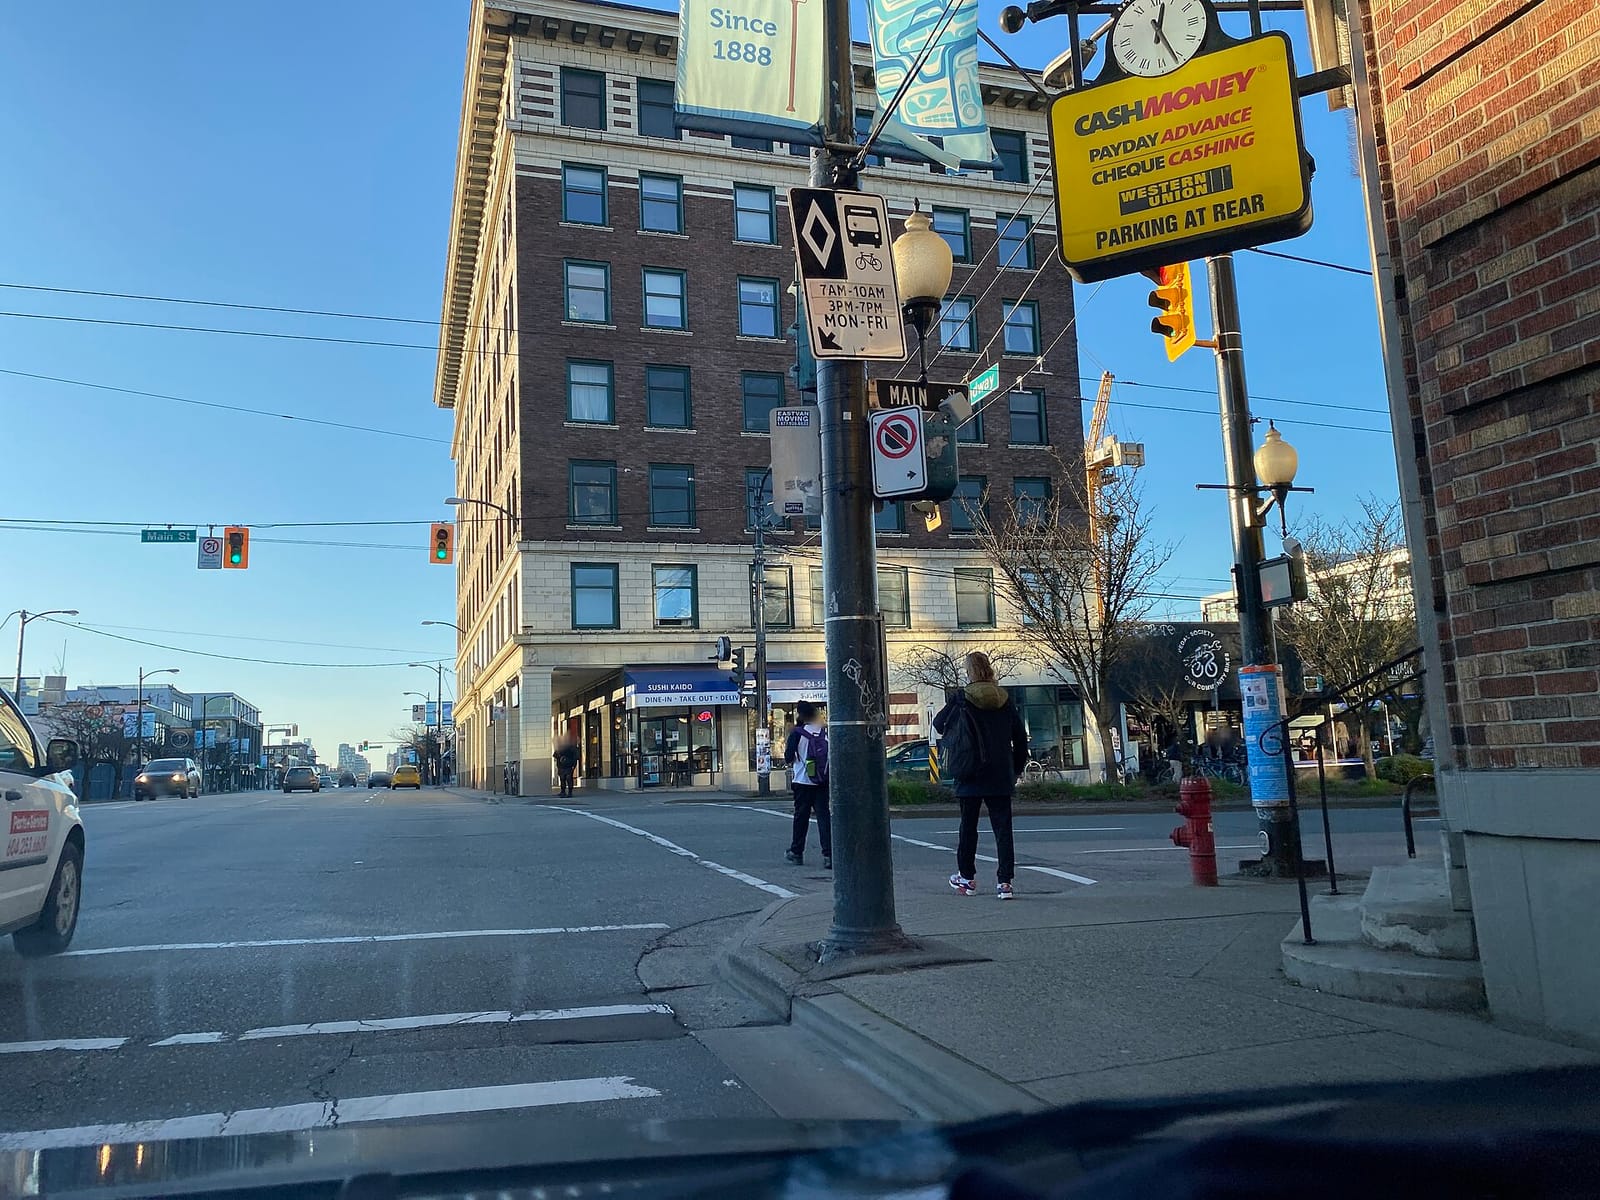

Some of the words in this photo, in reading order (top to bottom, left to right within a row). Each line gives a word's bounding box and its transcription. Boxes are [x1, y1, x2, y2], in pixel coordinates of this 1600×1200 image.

[710, 8, 777, 37] Since
[713, 40, 772, 67] 1888
[1089, 132, 1159, 163] PAYDAY
[1160, 107, 1253, 145] ADVANCE
[1092, 156, 1165, 186] CHEQUE
[1168, 131, 1255, 167] CASHING
[1120, 172, 1206, 203] WESTERN
[1148, 183, 1208, 208] UNION
[1096, 214, 1178, 250] PARKING
[1184, 207, 1206, 230] AT
[1213, 194, 1265, 223] REAR
[819, 284, 885, 299] 7AM-10AM
[828, 300, 883, 314] 3PM-7PM
[889, 385, 928, 407] MAIN
[147, 532, 173, 541] Main
[178, 532, 191, 541] St
[1190, 629, 1215, 638] SOCIETY
[1197, 673, 1227, 691] COMMNITY
